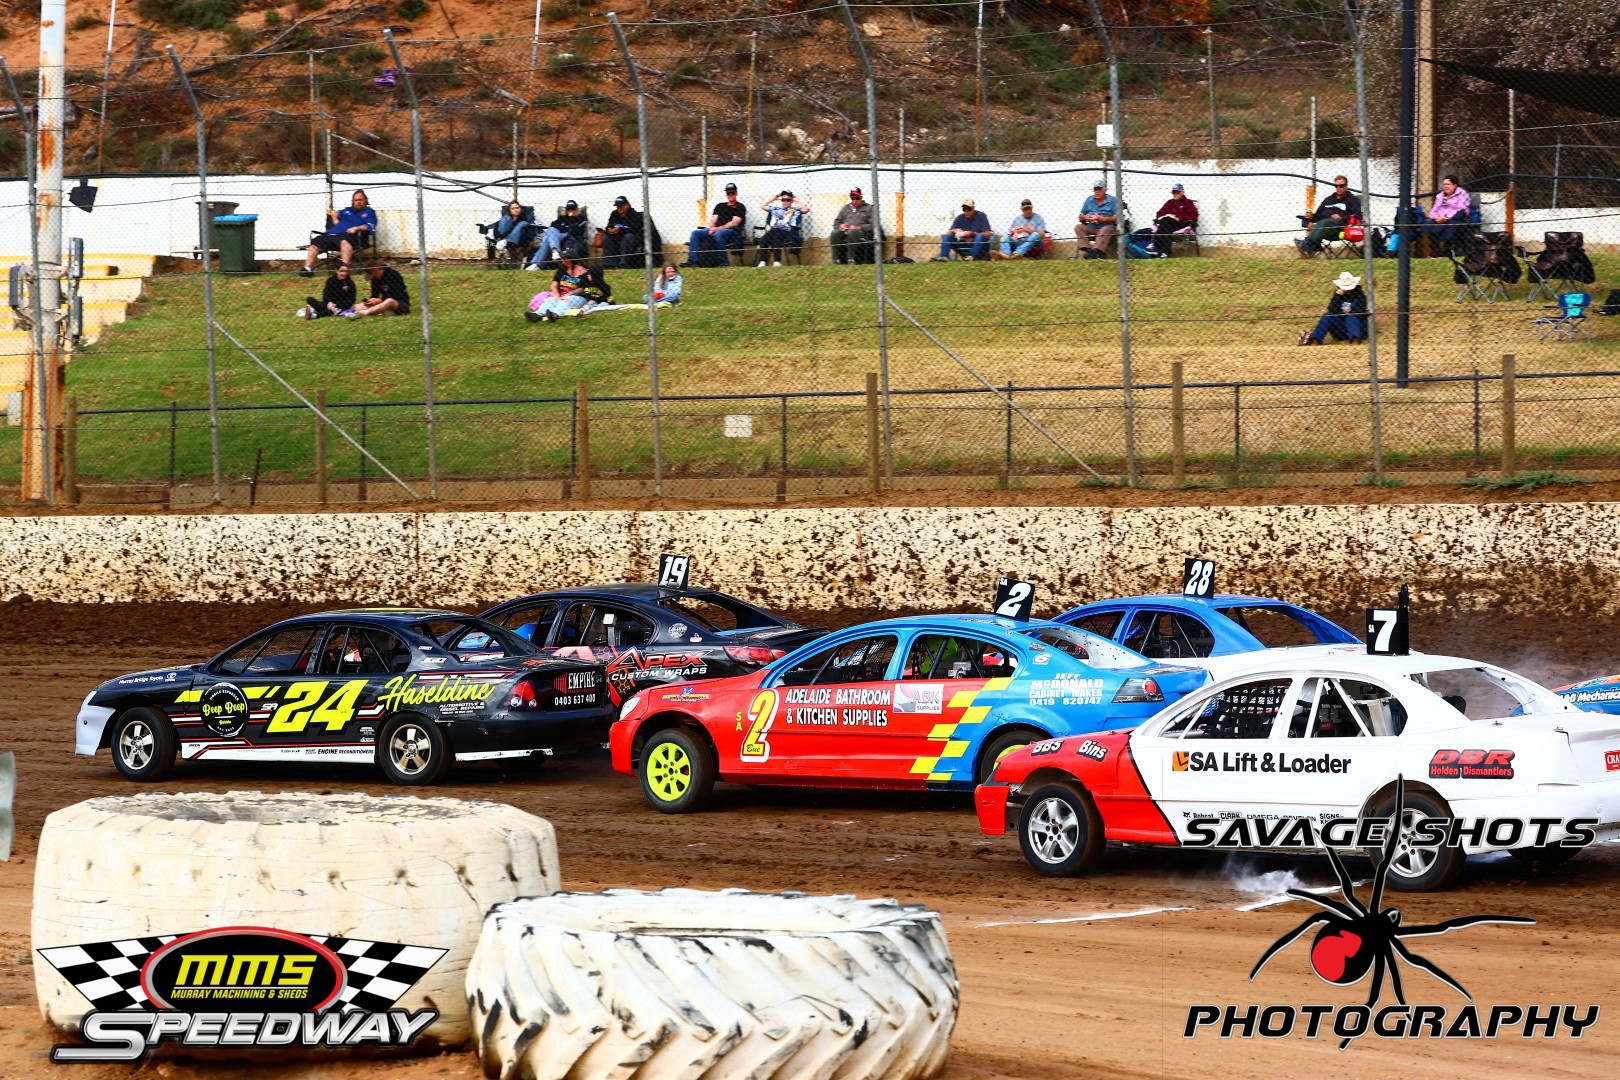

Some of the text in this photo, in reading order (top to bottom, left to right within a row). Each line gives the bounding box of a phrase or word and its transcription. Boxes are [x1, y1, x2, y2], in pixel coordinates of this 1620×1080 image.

[659, 555, 688, 588] 19
[1184, 560, 1214, 596] 28
[1000, 577, 1008, 586] SA
[996, 582, 1032, 618] 2
[1373, 609, 1398, 652] 7
[606, 646, 714, 674] APEX
[568, 671, 596, 689] EMPIRE
[611, 669, 660, 681] CUSTOM
[664, 667, 708, 677] WRAPS
[378, 673, 496, 712] Haseldine
[554, 695, 572, 705] 0403
[573, 694, 584, 704] 637
[785, 688, 891, 706] ADELAIDE BATHROOM
[912, 690, 939, 704] ABK
[1029, 689, 1103, 698] CABINET MAKER
[1029, 697, 1102, 706] 0419 820747
[1577, 688, 1620, 702] Mechanic
[202, 701, 245, 716] Beep Beep
[260, 703, 279, 711] SA
[266, 680, 369, 733] 24
[741, 688, 780, 763] 2
[786, 708, 888, 726] & KITCHEN SUPPLIES
[1077, 739, 1108, 761] Bins
[1431, 749, 1515, 765] DBR
[1189, 751, 1352, 773] SA Lift & Loader
[1431, 766, 1512, 776] Holden Dismantlers
